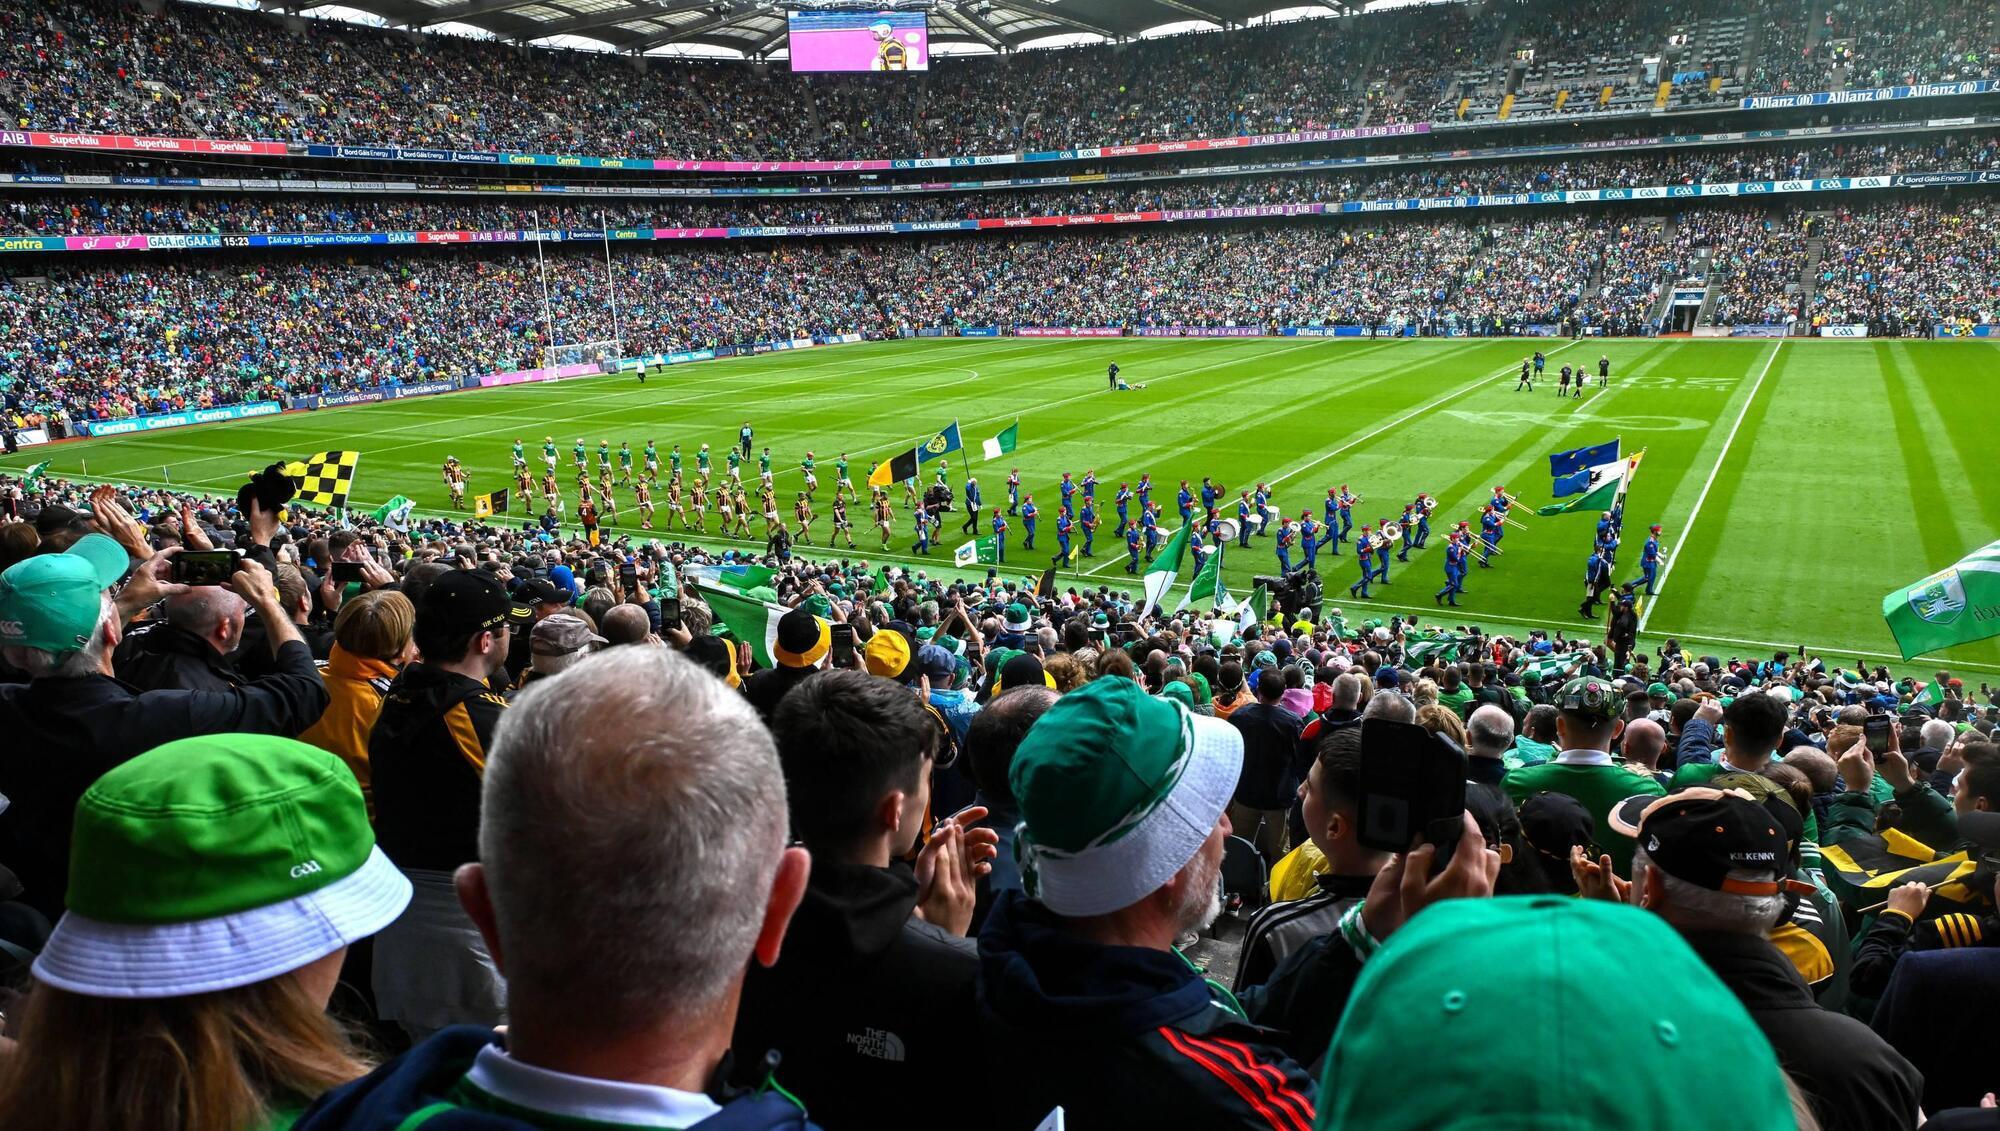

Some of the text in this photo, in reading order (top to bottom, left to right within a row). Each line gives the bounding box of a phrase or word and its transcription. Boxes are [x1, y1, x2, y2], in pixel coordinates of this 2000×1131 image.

[1907, 84, 1954, 98] Allianz
[1750, 96, 1794, 108] Allianz
[1826, 92, 1872, 104] Allianz
[1372, 128, 1387, 136] AIB
[1398, 125, 1414, 133] AIB
[2, 132, 26, 144] AIB
[1286, 134, 1300, 142] AIB
[1313, 132, 1328, 140] AIB
[1341, 130, 1356, 138] AIB
[50, 134, 99, 148] SuperValu
[134, 138, 179, 150] SuperValu
[1208, 138, 1238, 148] SuperValu
[1261, 136, 1275, 144] AIB
[210, 140, 252, 152] SuperValu
[1110, 146, 1138, 155] SuperValu
[1158, 142, 1188, 152] SuperValu
[370, 150, 388, 159] Energy
[428, 152, 444, 160] Energy
[510, 154, 535, 164] Centra
[556, 156, 580, 166] Centra
[600, 158, 622, 168] Centra
[1782, 181, 1803, 190] GAA
[1820, 180, 1841, 189] GAA
[1859, 178, 1880, 187] GAA
[1674, 187, 1694, 196] GAA
[1710, 185, 1729, 194] GAA
[1745, 183, 1766, 192] GAA
[1541, 193, 1560, 201] GAA
[1573, 192, 1591, 200] GAA
[1606, 190, 1625, 198] GAA
[1640, 189, 1658, 197] GAA
[1418, 198, 1453, 208] Allianz
[1478, 196, 1513, 206] Allianz
[1269, 206, 1283, 215] AIB
[1296, 205, 1310, 213] AIB
[1360, 201, 1393, 211] Allianz
[1220, 209, 1233, 217] AIB
[1244, 208, 1257, 216] AIB
[1068, 215, 1095, 224] SuperValu
[1114, 213, 1142, 222] SuperValu
[1004, 218, 1032, 227] SuperValu
[149, 236, 185, 246] GAA.ie
[186, 236, 220, 246] GAA.ie
[224, 237, 249, 246] 15:23
[388, 232, 415, 242] GAA.ie
[428, 233, 459, 242] SuperValu
[1296, 328, 1323, 336] Allianz
[1833, 328, 1854, 336] GAA
[1951, 328, 1975, 336] GA
[402, 387, 419, 395] Bord
[432, 383, 452, 393] Energy
[326, 396, 344, 404] Bord
[360, 392, 383, 402] Energy
[240, 404, 275, 416] Centra
[195, 409, 231, 422] Centra
[146, 415, 186, 428] Centra
[95, 422, 137, 434] Centra
[1730, 852, 1775, 860] KILKENNY
[865, 1027, 886, 1038] THE
[847, 1032, 884, 1049] NORTH
[857, 1042, 883, 1058] FACE
